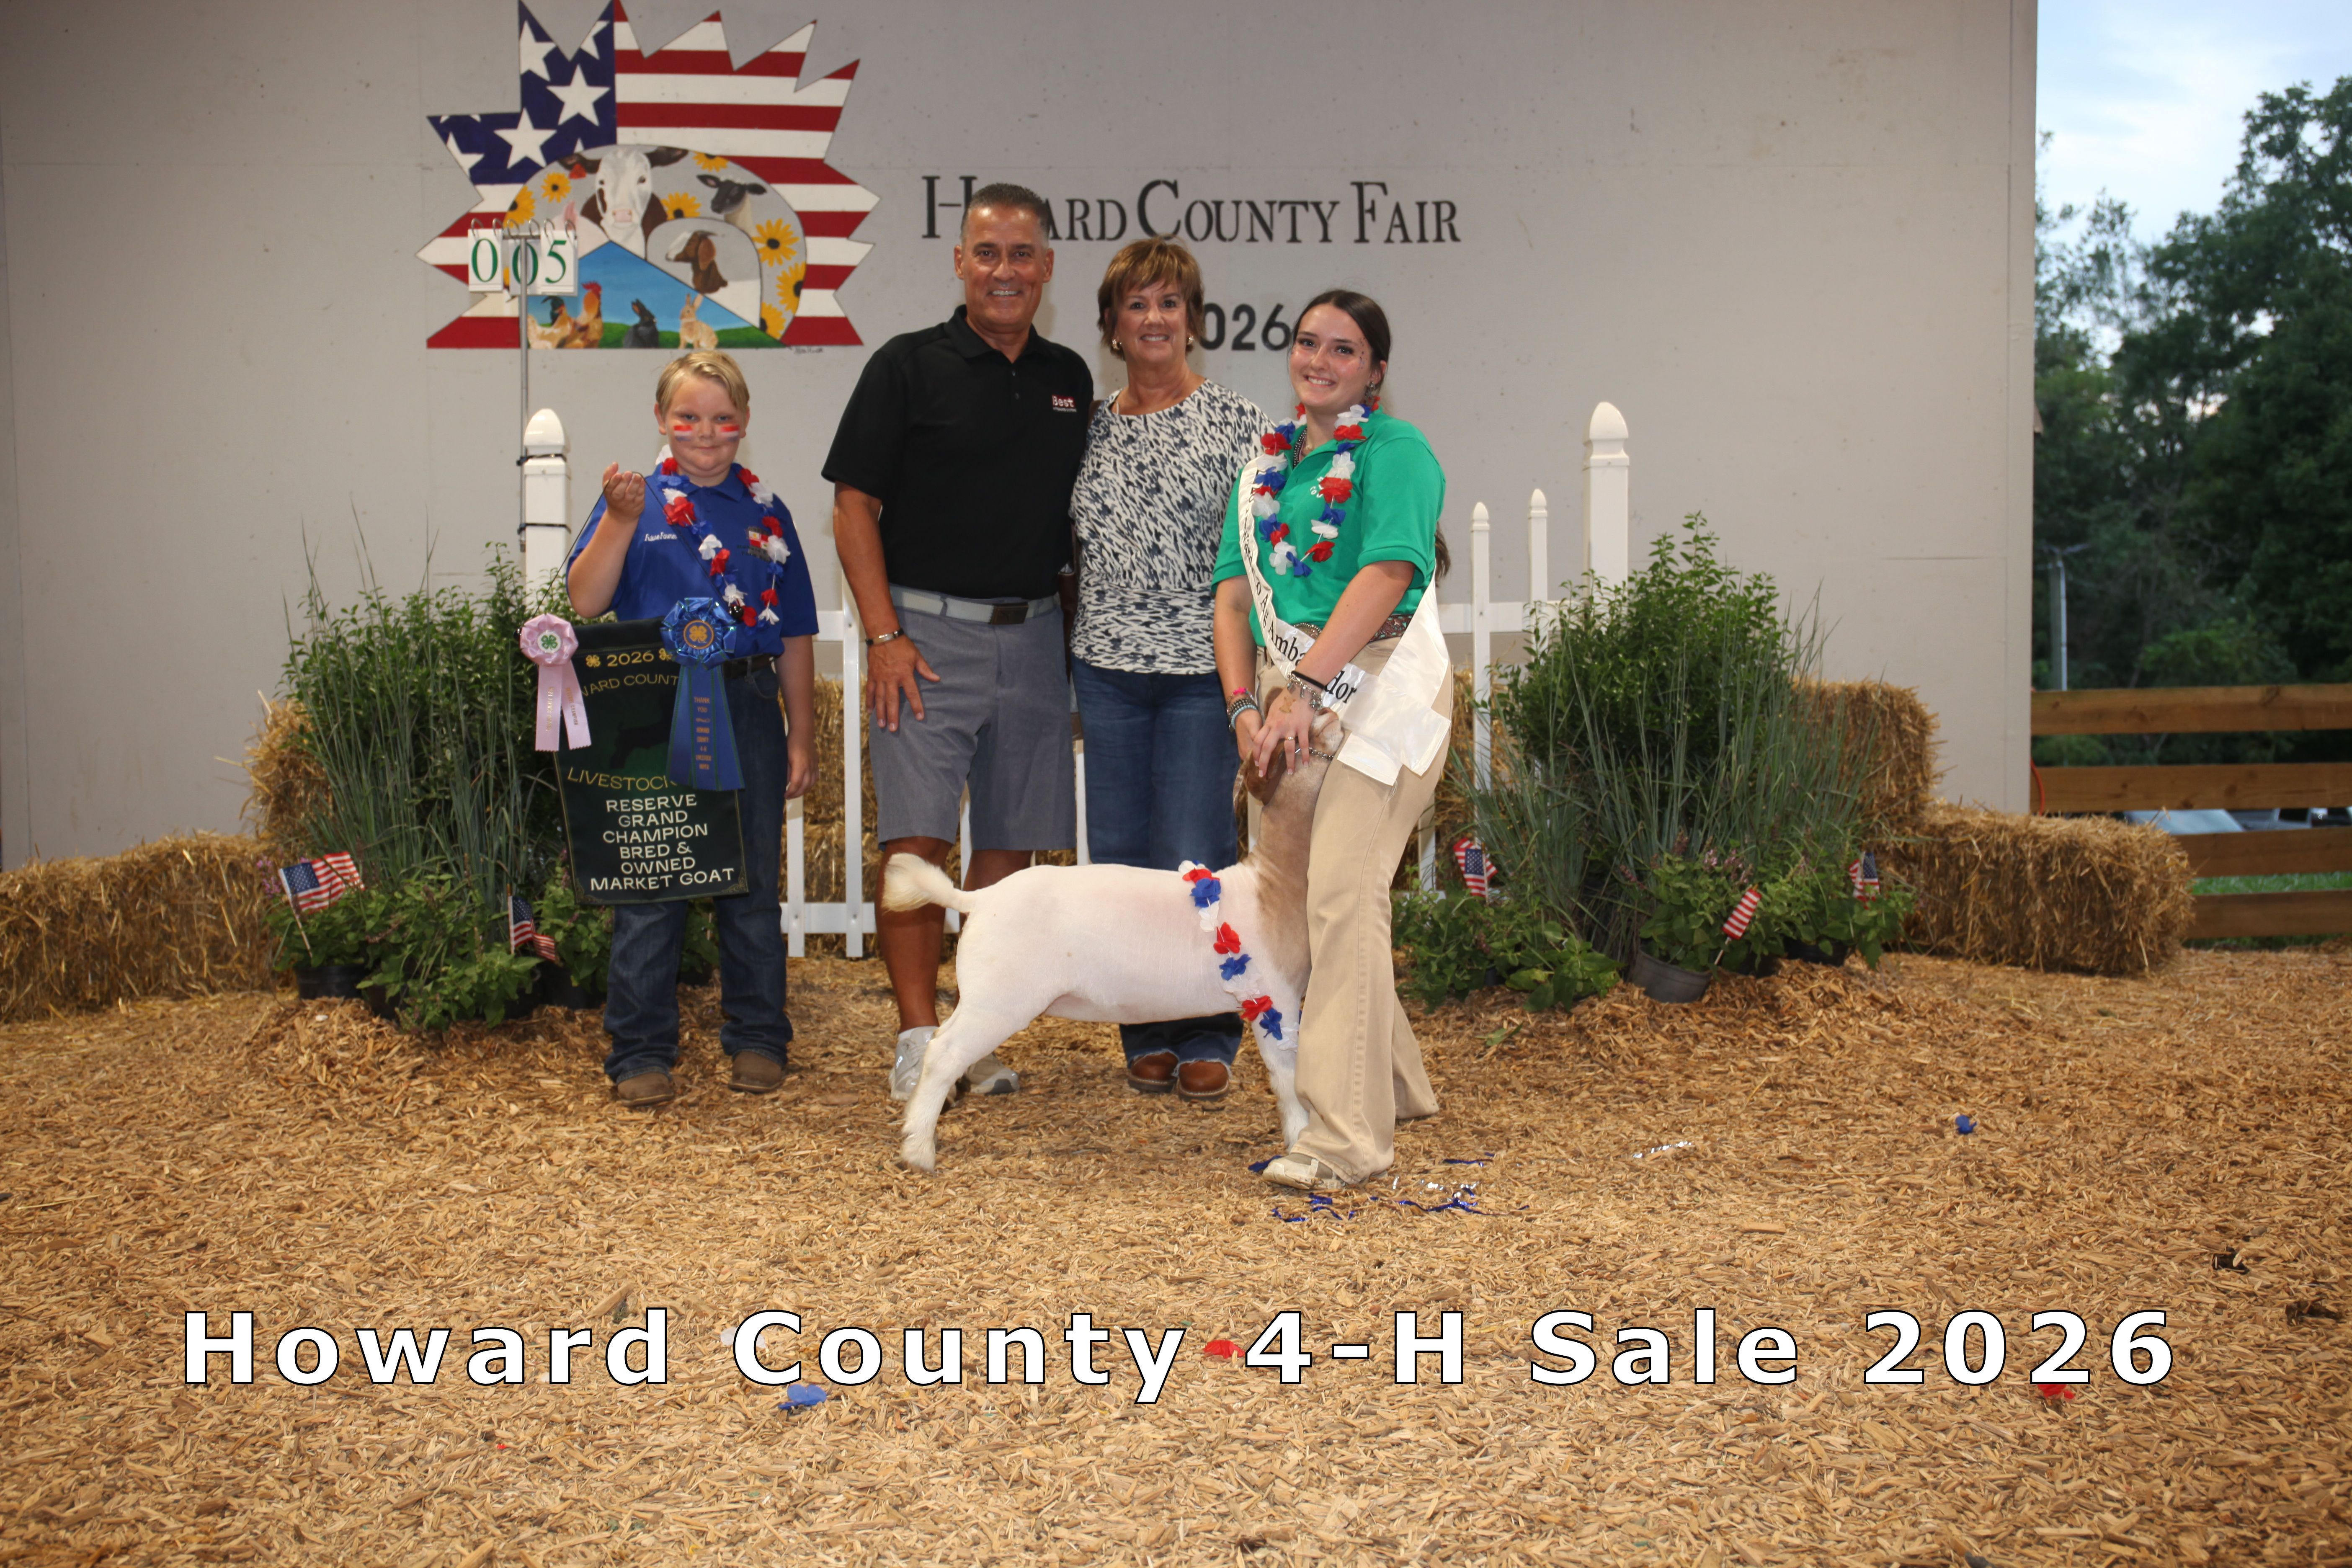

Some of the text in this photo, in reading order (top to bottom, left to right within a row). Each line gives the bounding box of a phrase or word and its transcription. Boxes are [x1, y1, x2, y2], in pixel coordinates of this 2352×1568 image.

[922, 176, 1461, 243] HARD COUNTY FAIR
[1203, 303, 1290, 351] 026
[1052, 395, 1074, 407] Best
[1261, 593, 1269, 629] Ag
[1268, 621, 1357, 704] Ambador
[607, 650, 654, 667] 2026
[581, 673, 679, 696] ARD COUNT
[606, 794, 697, 812] RESERVE
[618, 810, 688, 828] GRAND
[603, 823, 708, 843] CHAMPION
[619, 841, 692, 859] BRED &
[621, 857, 696, 874] OWNED
[591, 868, 734, 891] MARKET GOAT
